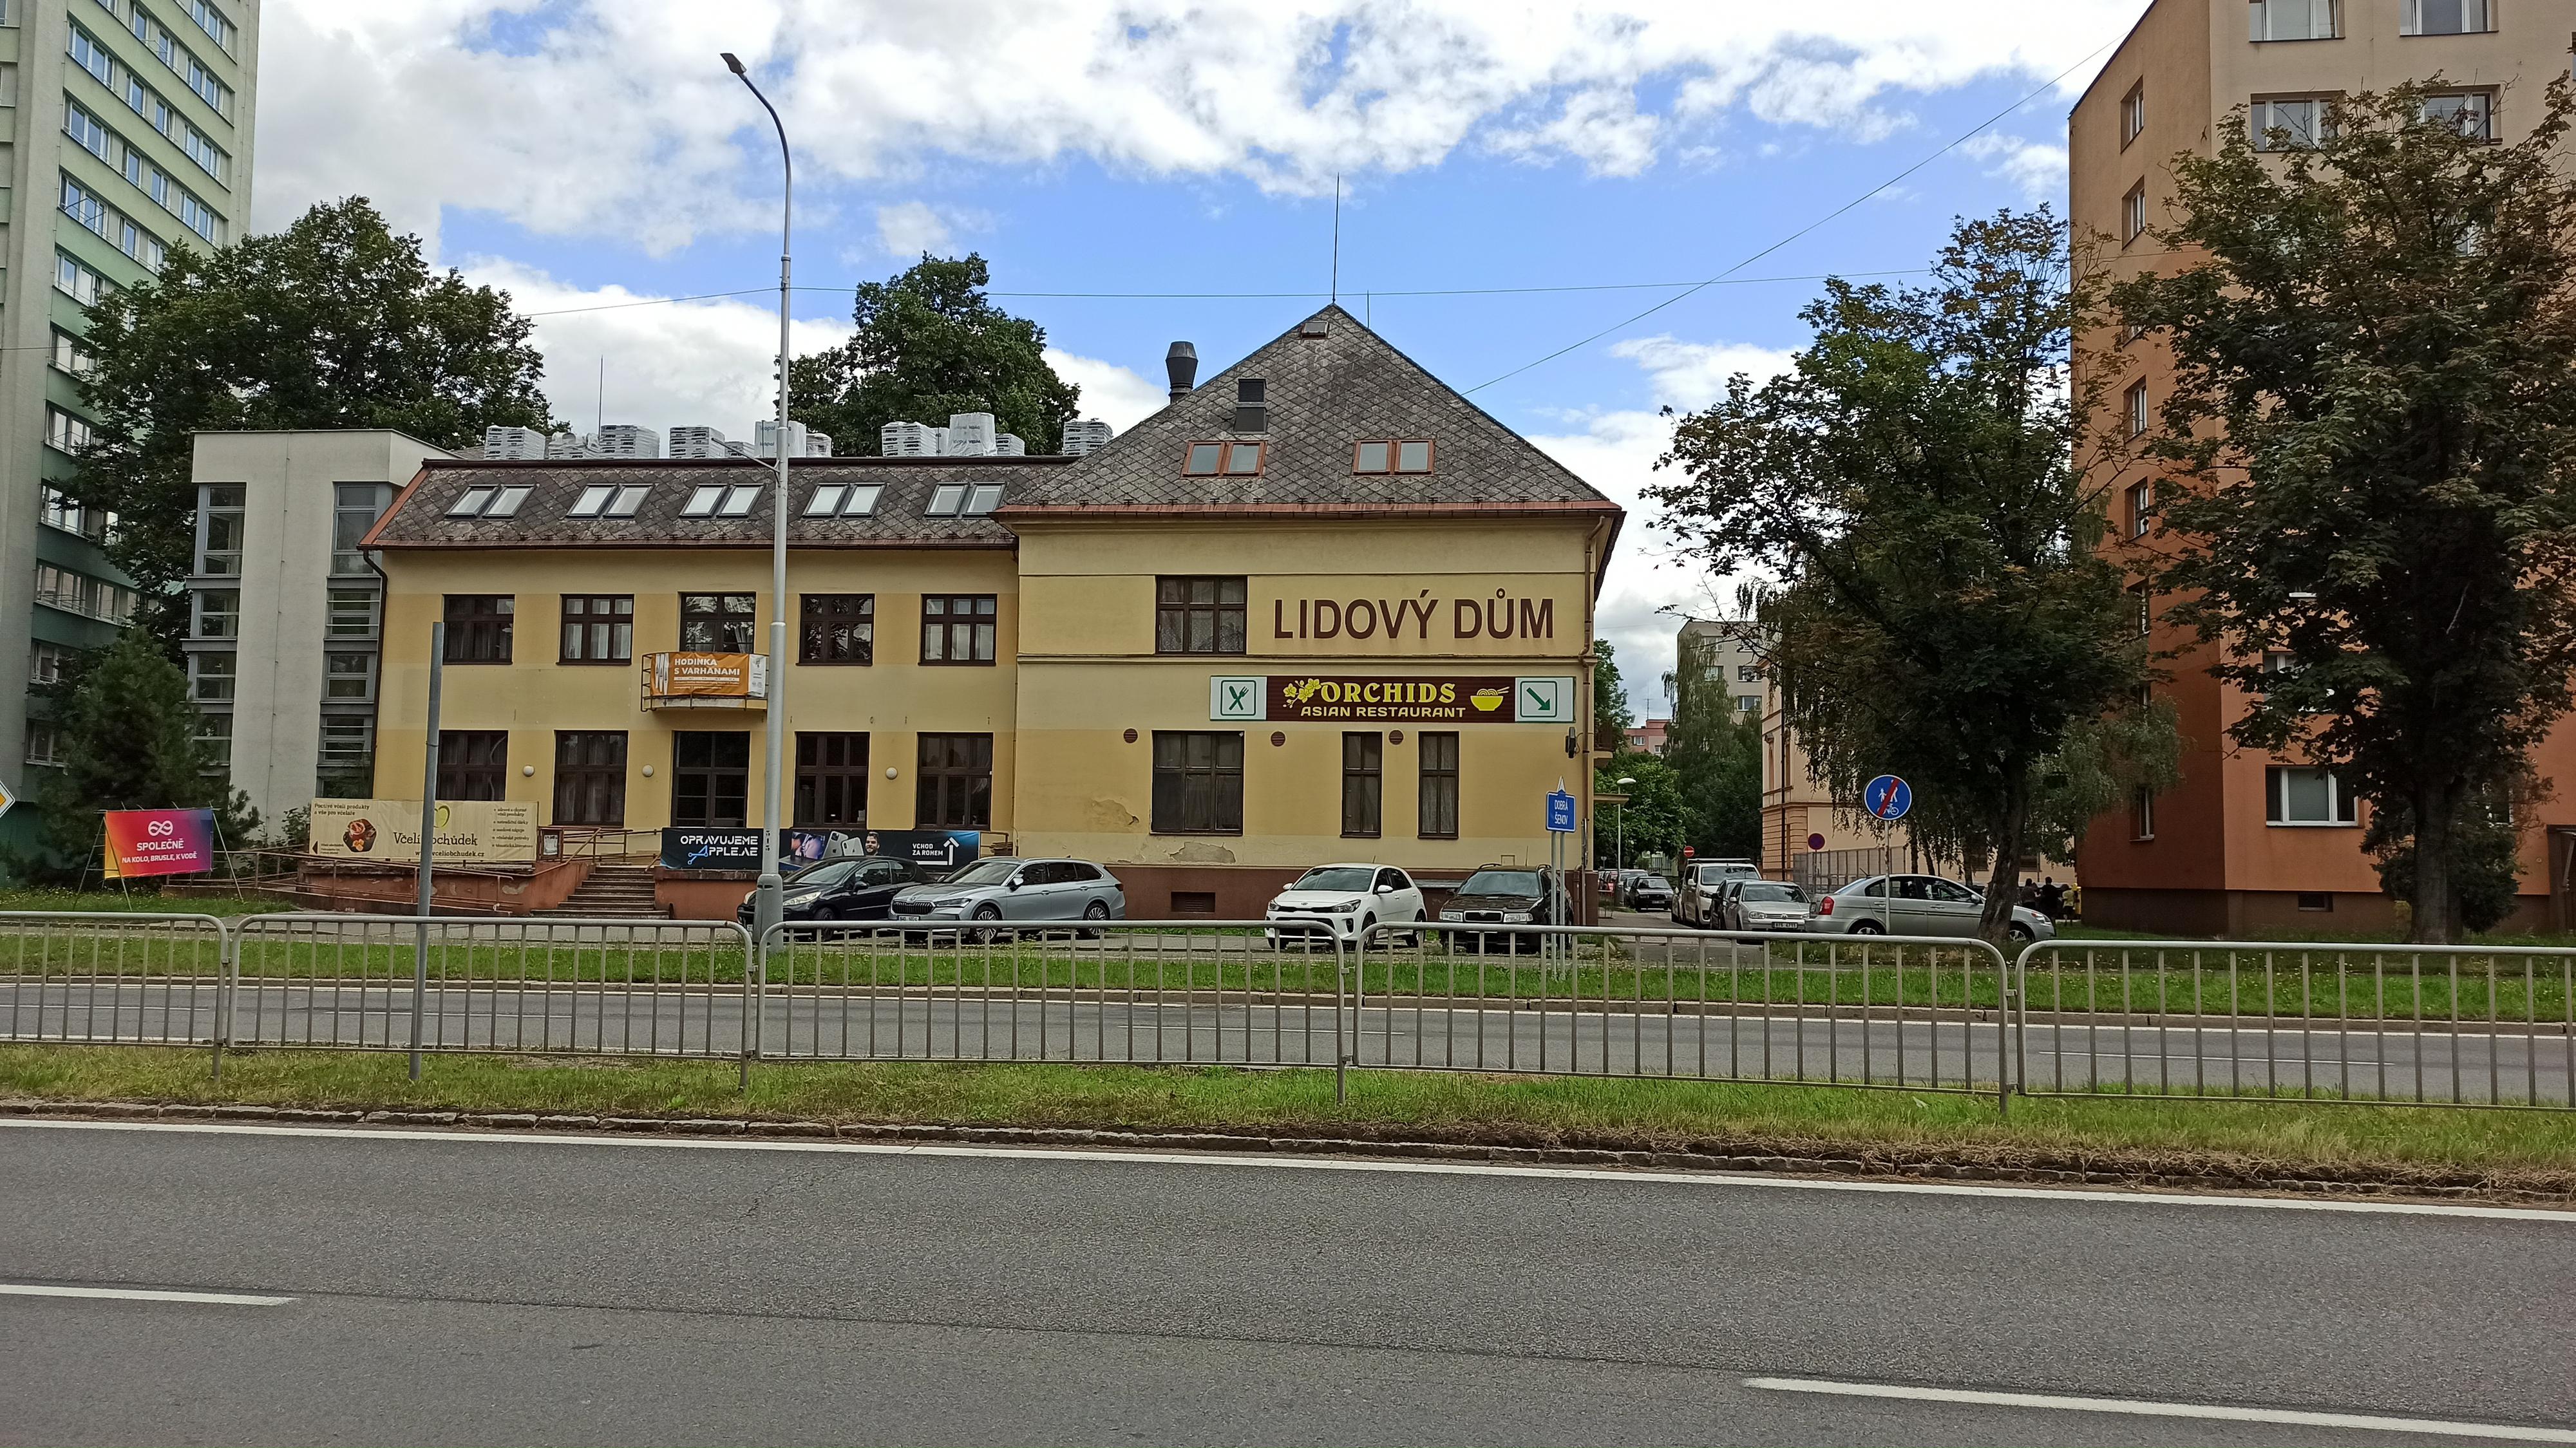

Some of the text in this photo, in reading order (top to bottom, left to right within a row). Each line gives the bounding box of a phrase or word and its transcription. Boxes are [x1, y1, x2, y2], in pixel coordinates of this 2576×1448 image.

[1274, 587, 1553, 639] LIDOVÝ DŮM
[682, 667, 740, 675] VARHANAMI
[1320, 681, 1456, 704] ORCHIDS
[1300, 706, 1466, 718] ASIAN RESTAURANT
[1554, 798, 1569, 811] DOBRÁ
[1555, 811, 1568, 825] ŠENOV
[393, 832, 421, 844] Včelí
[680, 835, 759, 845] OPRAVUJEME
[137, 838, 184, 852] SPOLEČNĚ
[181, 851, 198, 859] VODĚ
